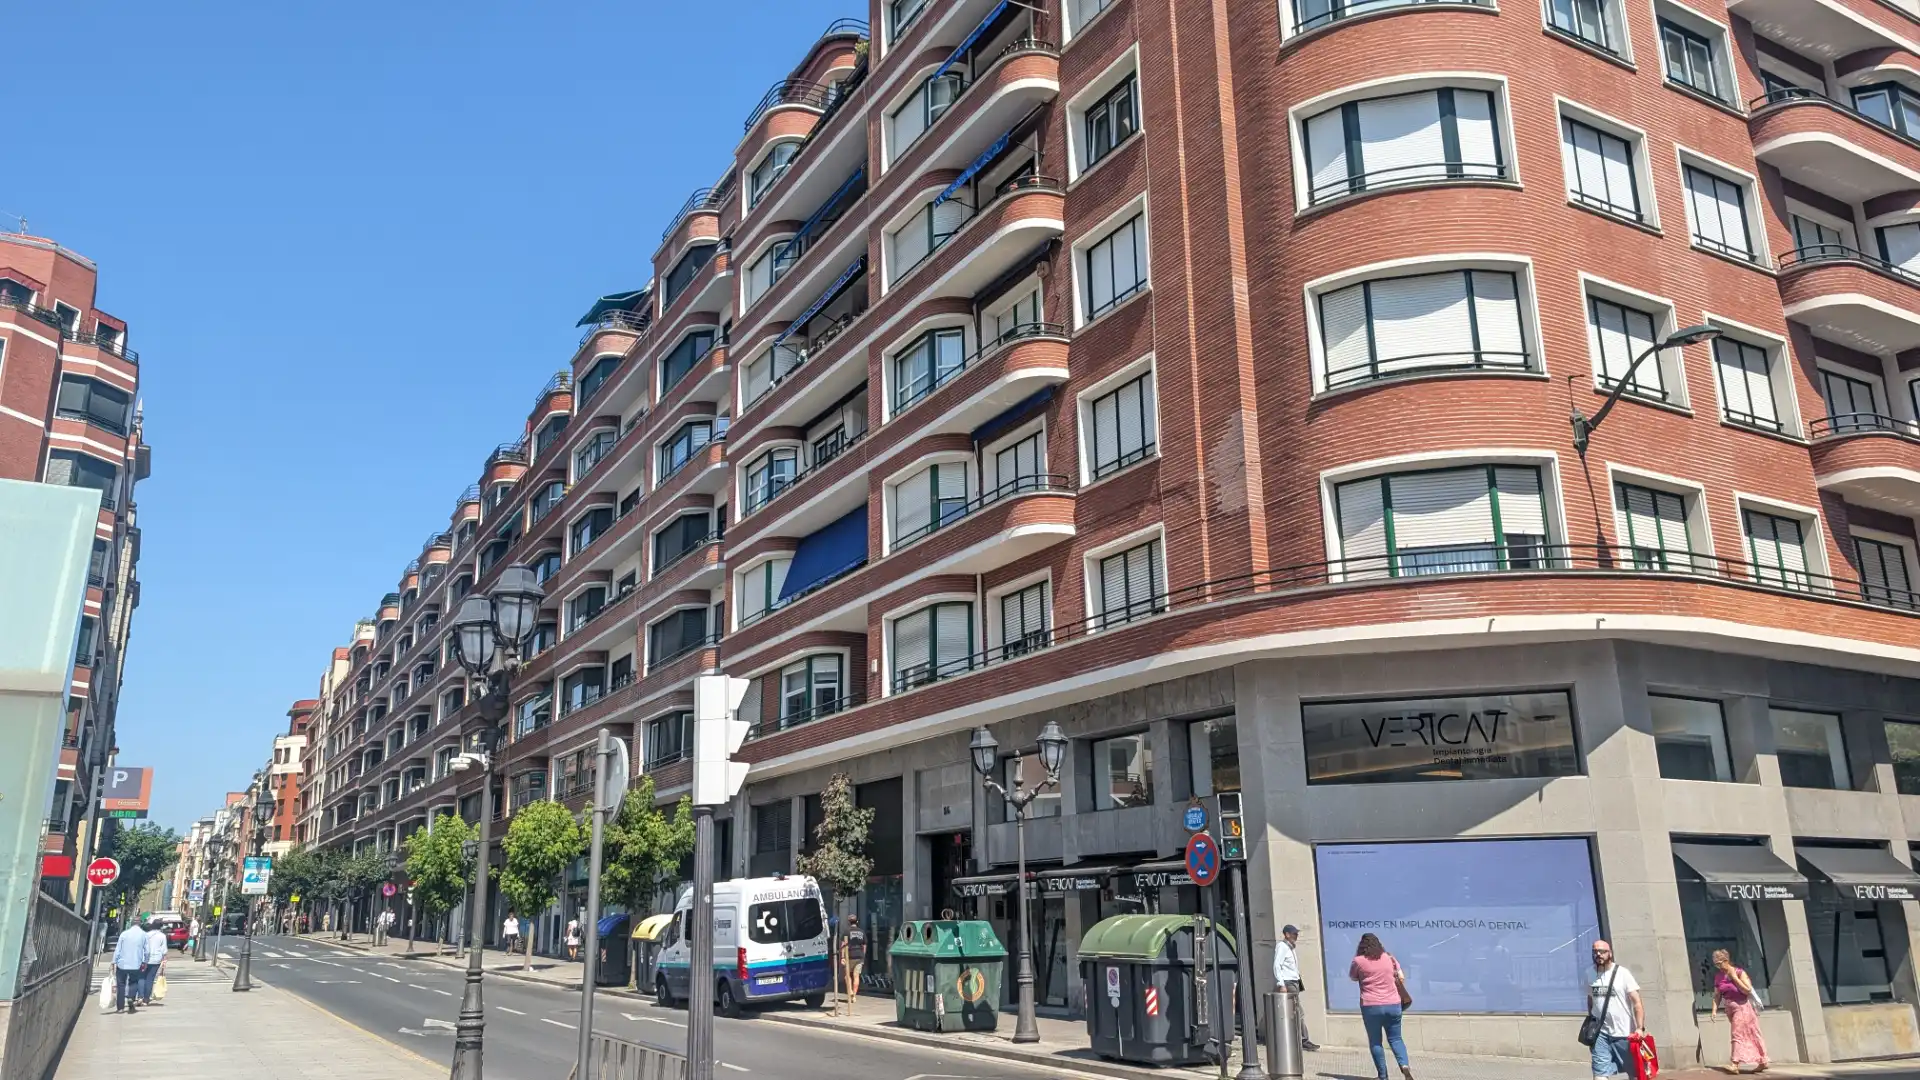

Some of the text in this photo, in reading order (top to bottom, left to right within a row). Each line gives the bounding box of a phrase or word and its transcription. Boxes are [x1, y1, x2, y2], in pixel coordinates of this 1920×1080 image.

[1361, 710, 1508, 747] VERICAT
[112, 770, 129, 788] P
[90, 868, 114, 876] STOP
[1047, 878, 1075, 890] VERICAT
[1134, 873, 1168, 887] VERICAT
[1725, 884, 1762, 899] VERICAT
[1853, 885, 1885, 899] VERICAT
[1328, 920, 1381, 929] PIONEROS
[1383, 920, 1397, 929] EN
[1489, 921, 1530, 930] DENTAL
